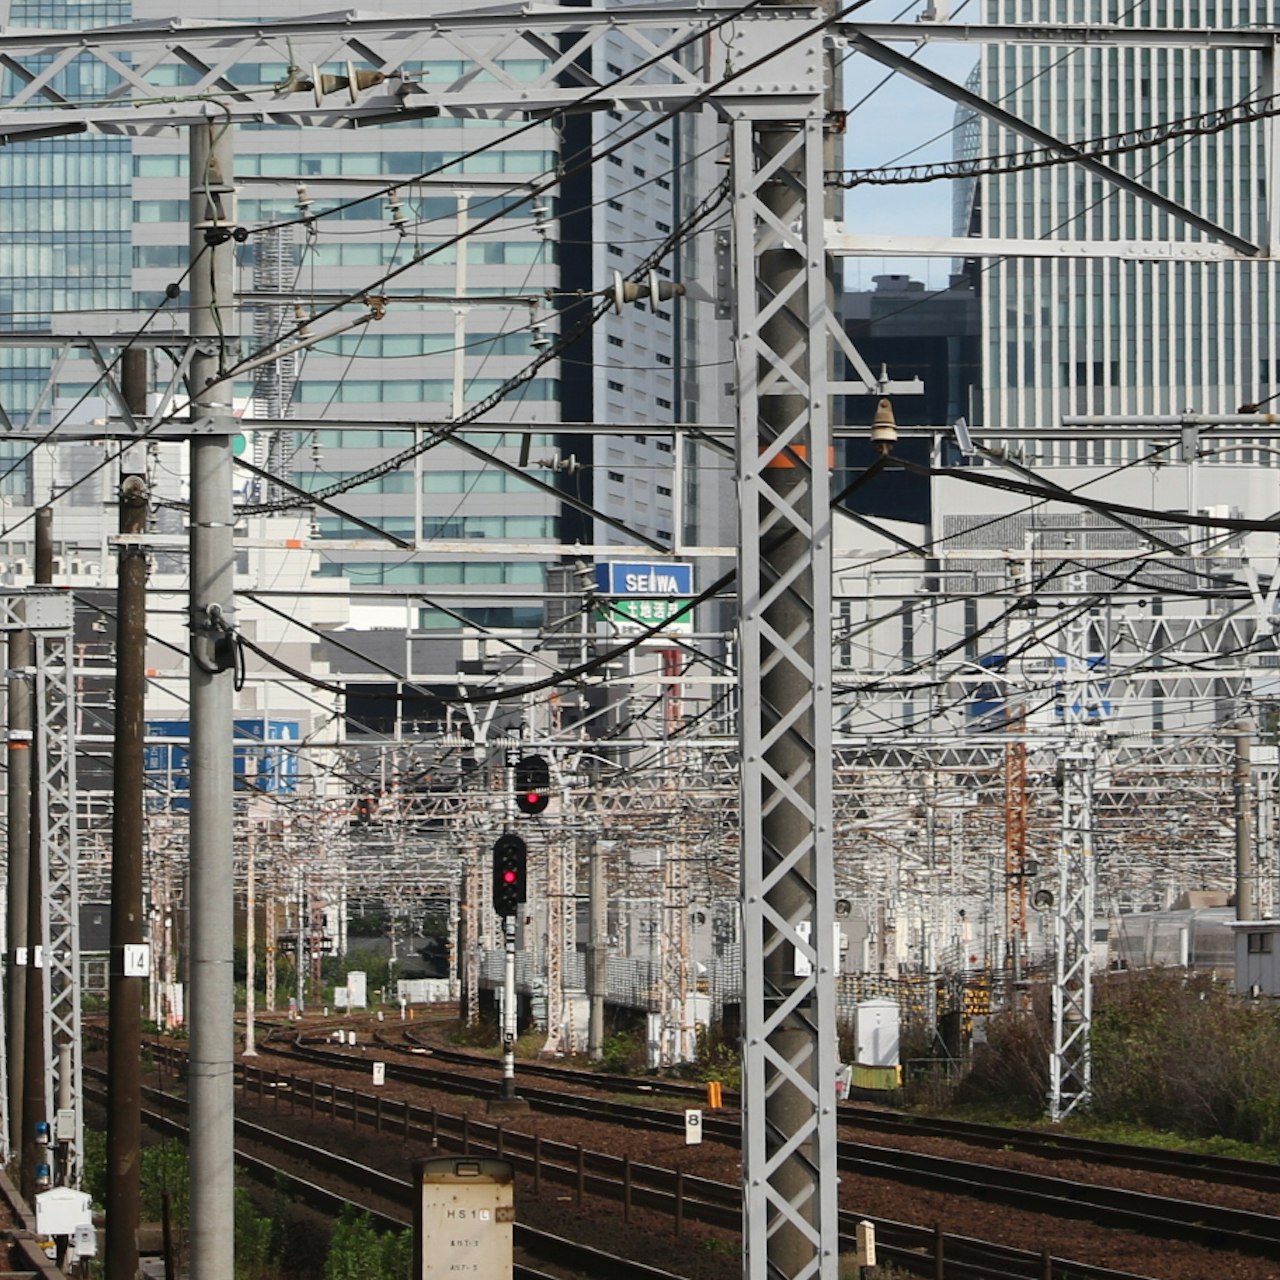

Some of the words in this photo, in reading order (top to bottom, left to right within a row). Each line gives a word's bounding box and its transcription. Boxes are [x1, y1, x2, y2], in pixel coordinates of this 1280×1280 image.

[625, 566, 679, 593] SEIWA
[131, 951, 144, 969] 14
[687, 1113, 699, 1126] 8
